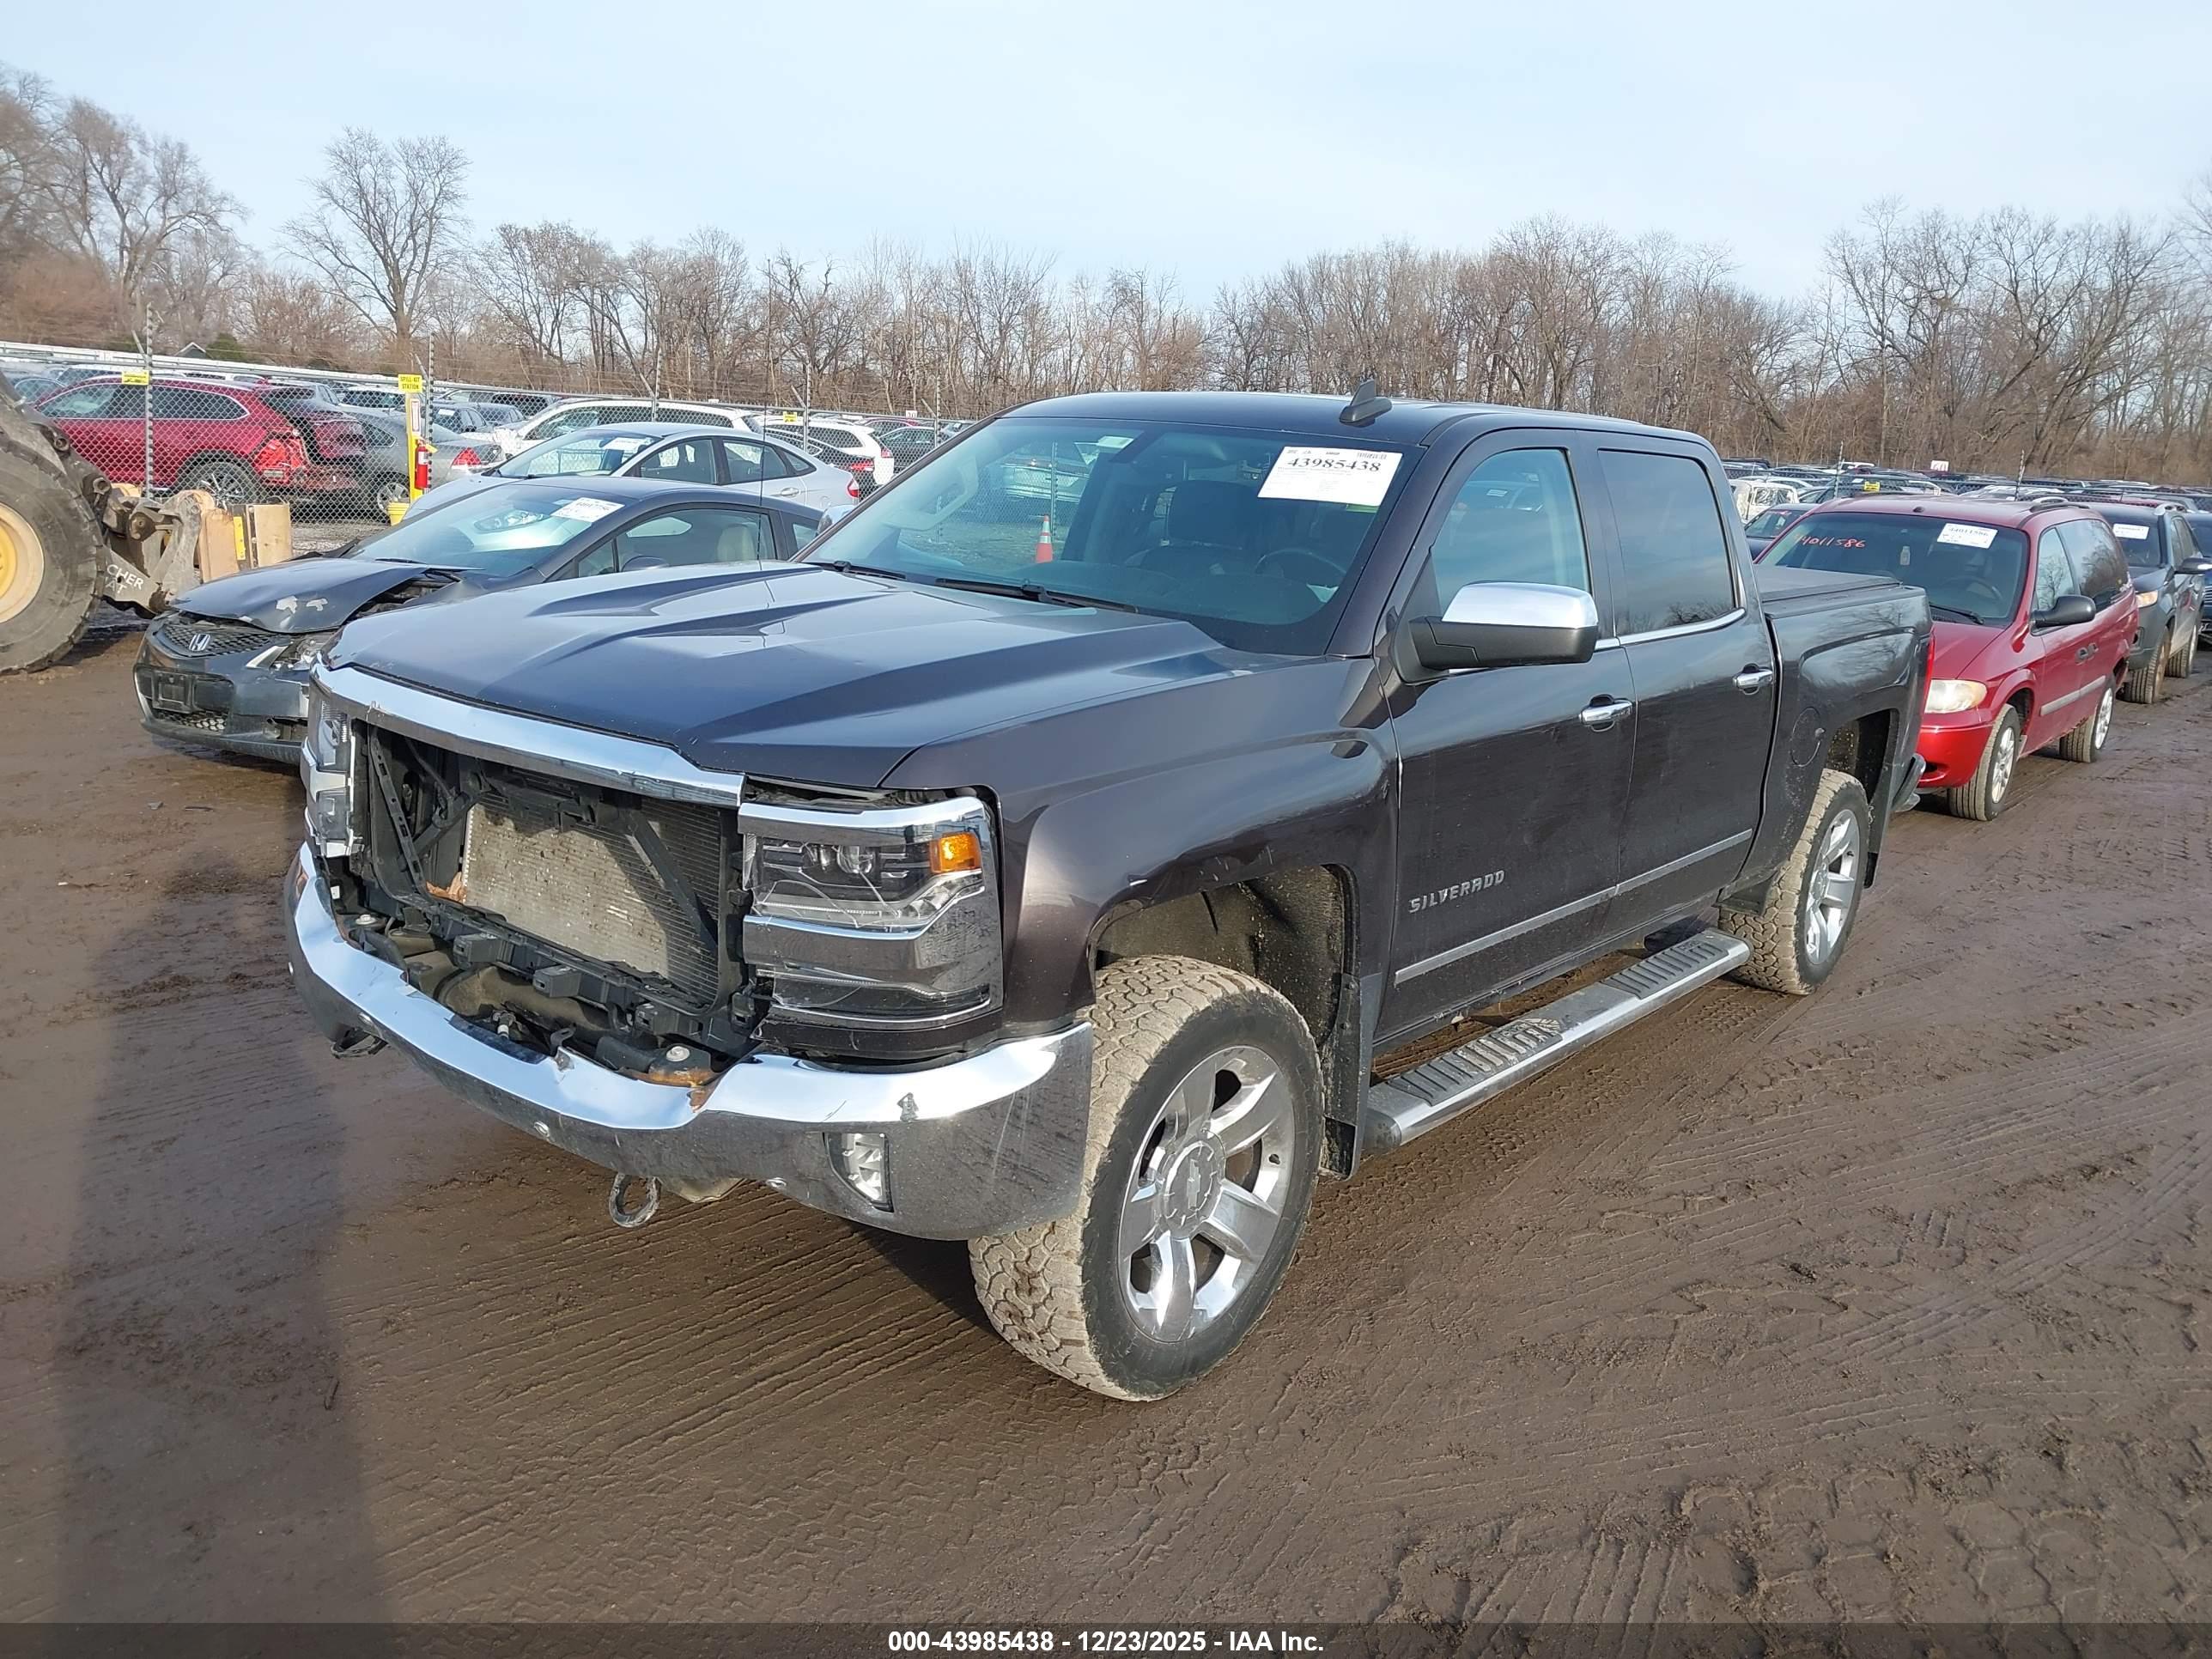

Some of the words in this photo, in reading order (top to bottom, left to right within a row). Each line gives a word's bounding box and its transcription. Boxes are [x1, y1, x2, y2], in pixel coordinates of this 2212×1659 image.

[1287, 458, 1381, 471] 43985438
[106, 562, 144, 591] CHER
[1408, 870, 1505, 914] SILVERADO
